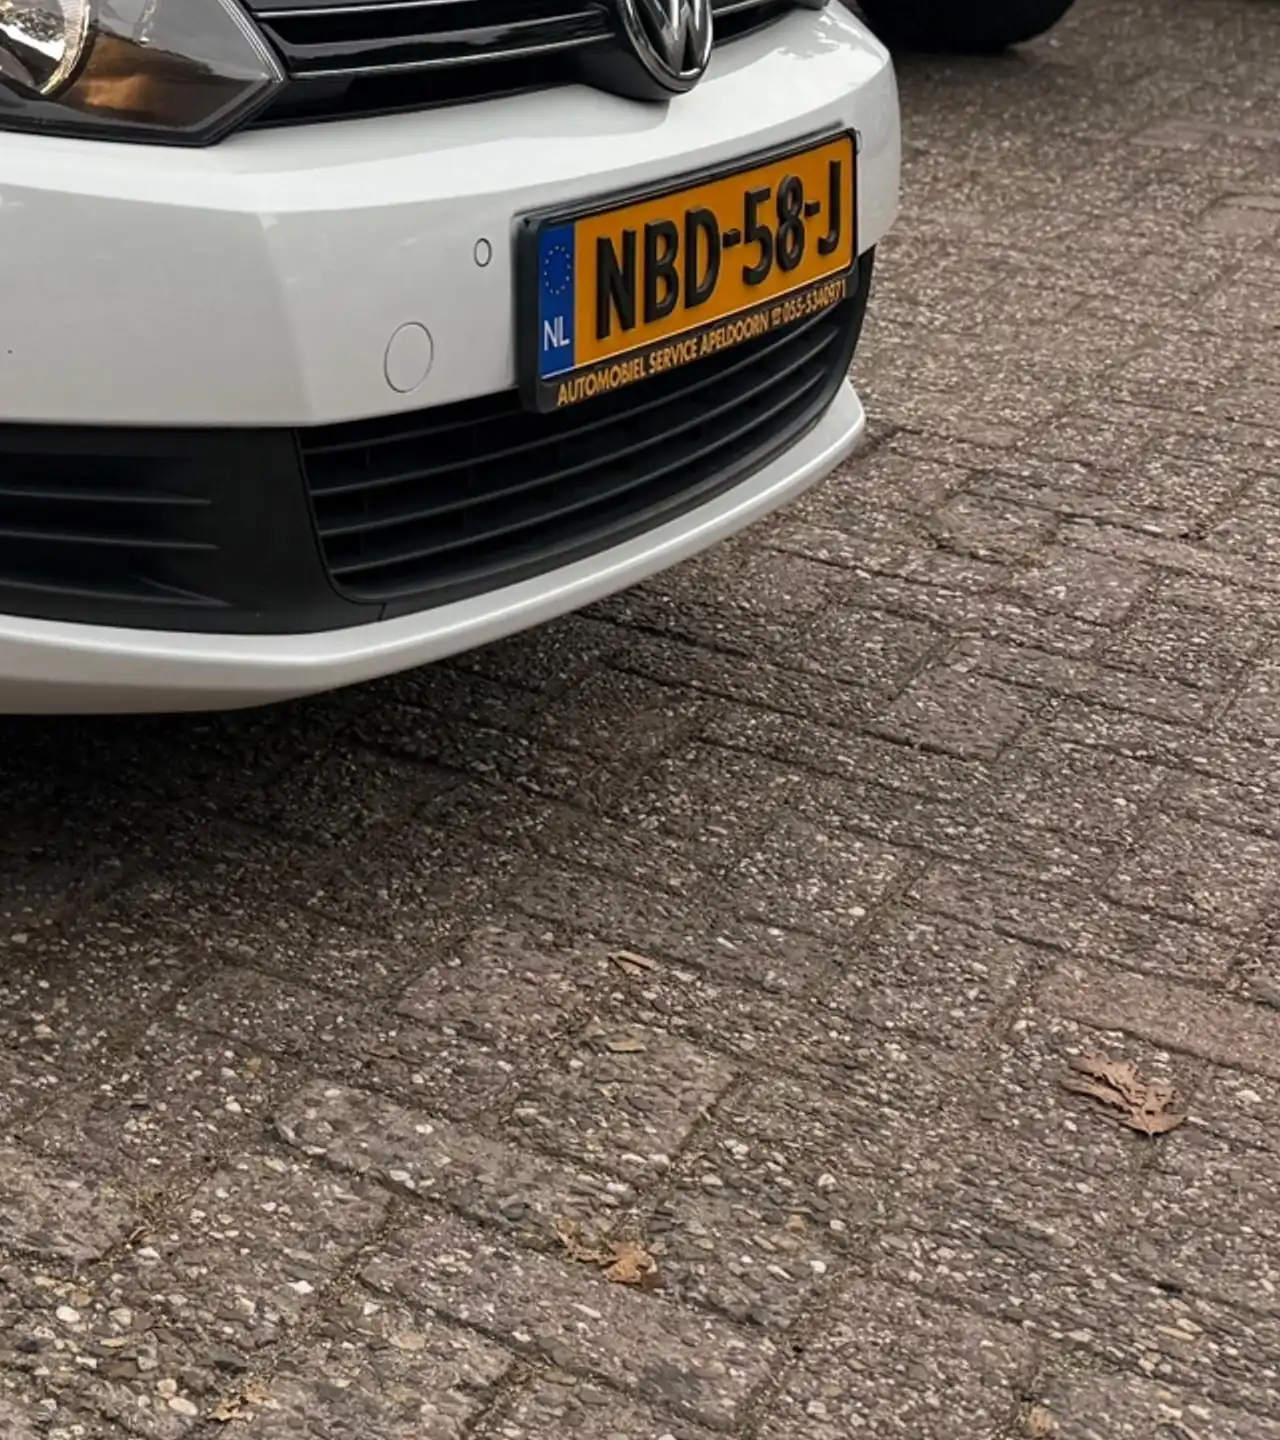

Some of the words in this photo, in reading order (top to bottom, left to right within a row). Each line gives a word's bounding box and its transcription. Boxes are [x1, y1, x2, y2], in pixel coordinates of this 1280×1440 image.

[543, 316, 570, 351] NL
[596, 160, 841, 341] NBD-58-J
[557, 356, 646, 407] AUTOMOBIEL
[649, 337, 698, 374] SERVICE
[700, 311, 769, 356] APELDOORN
